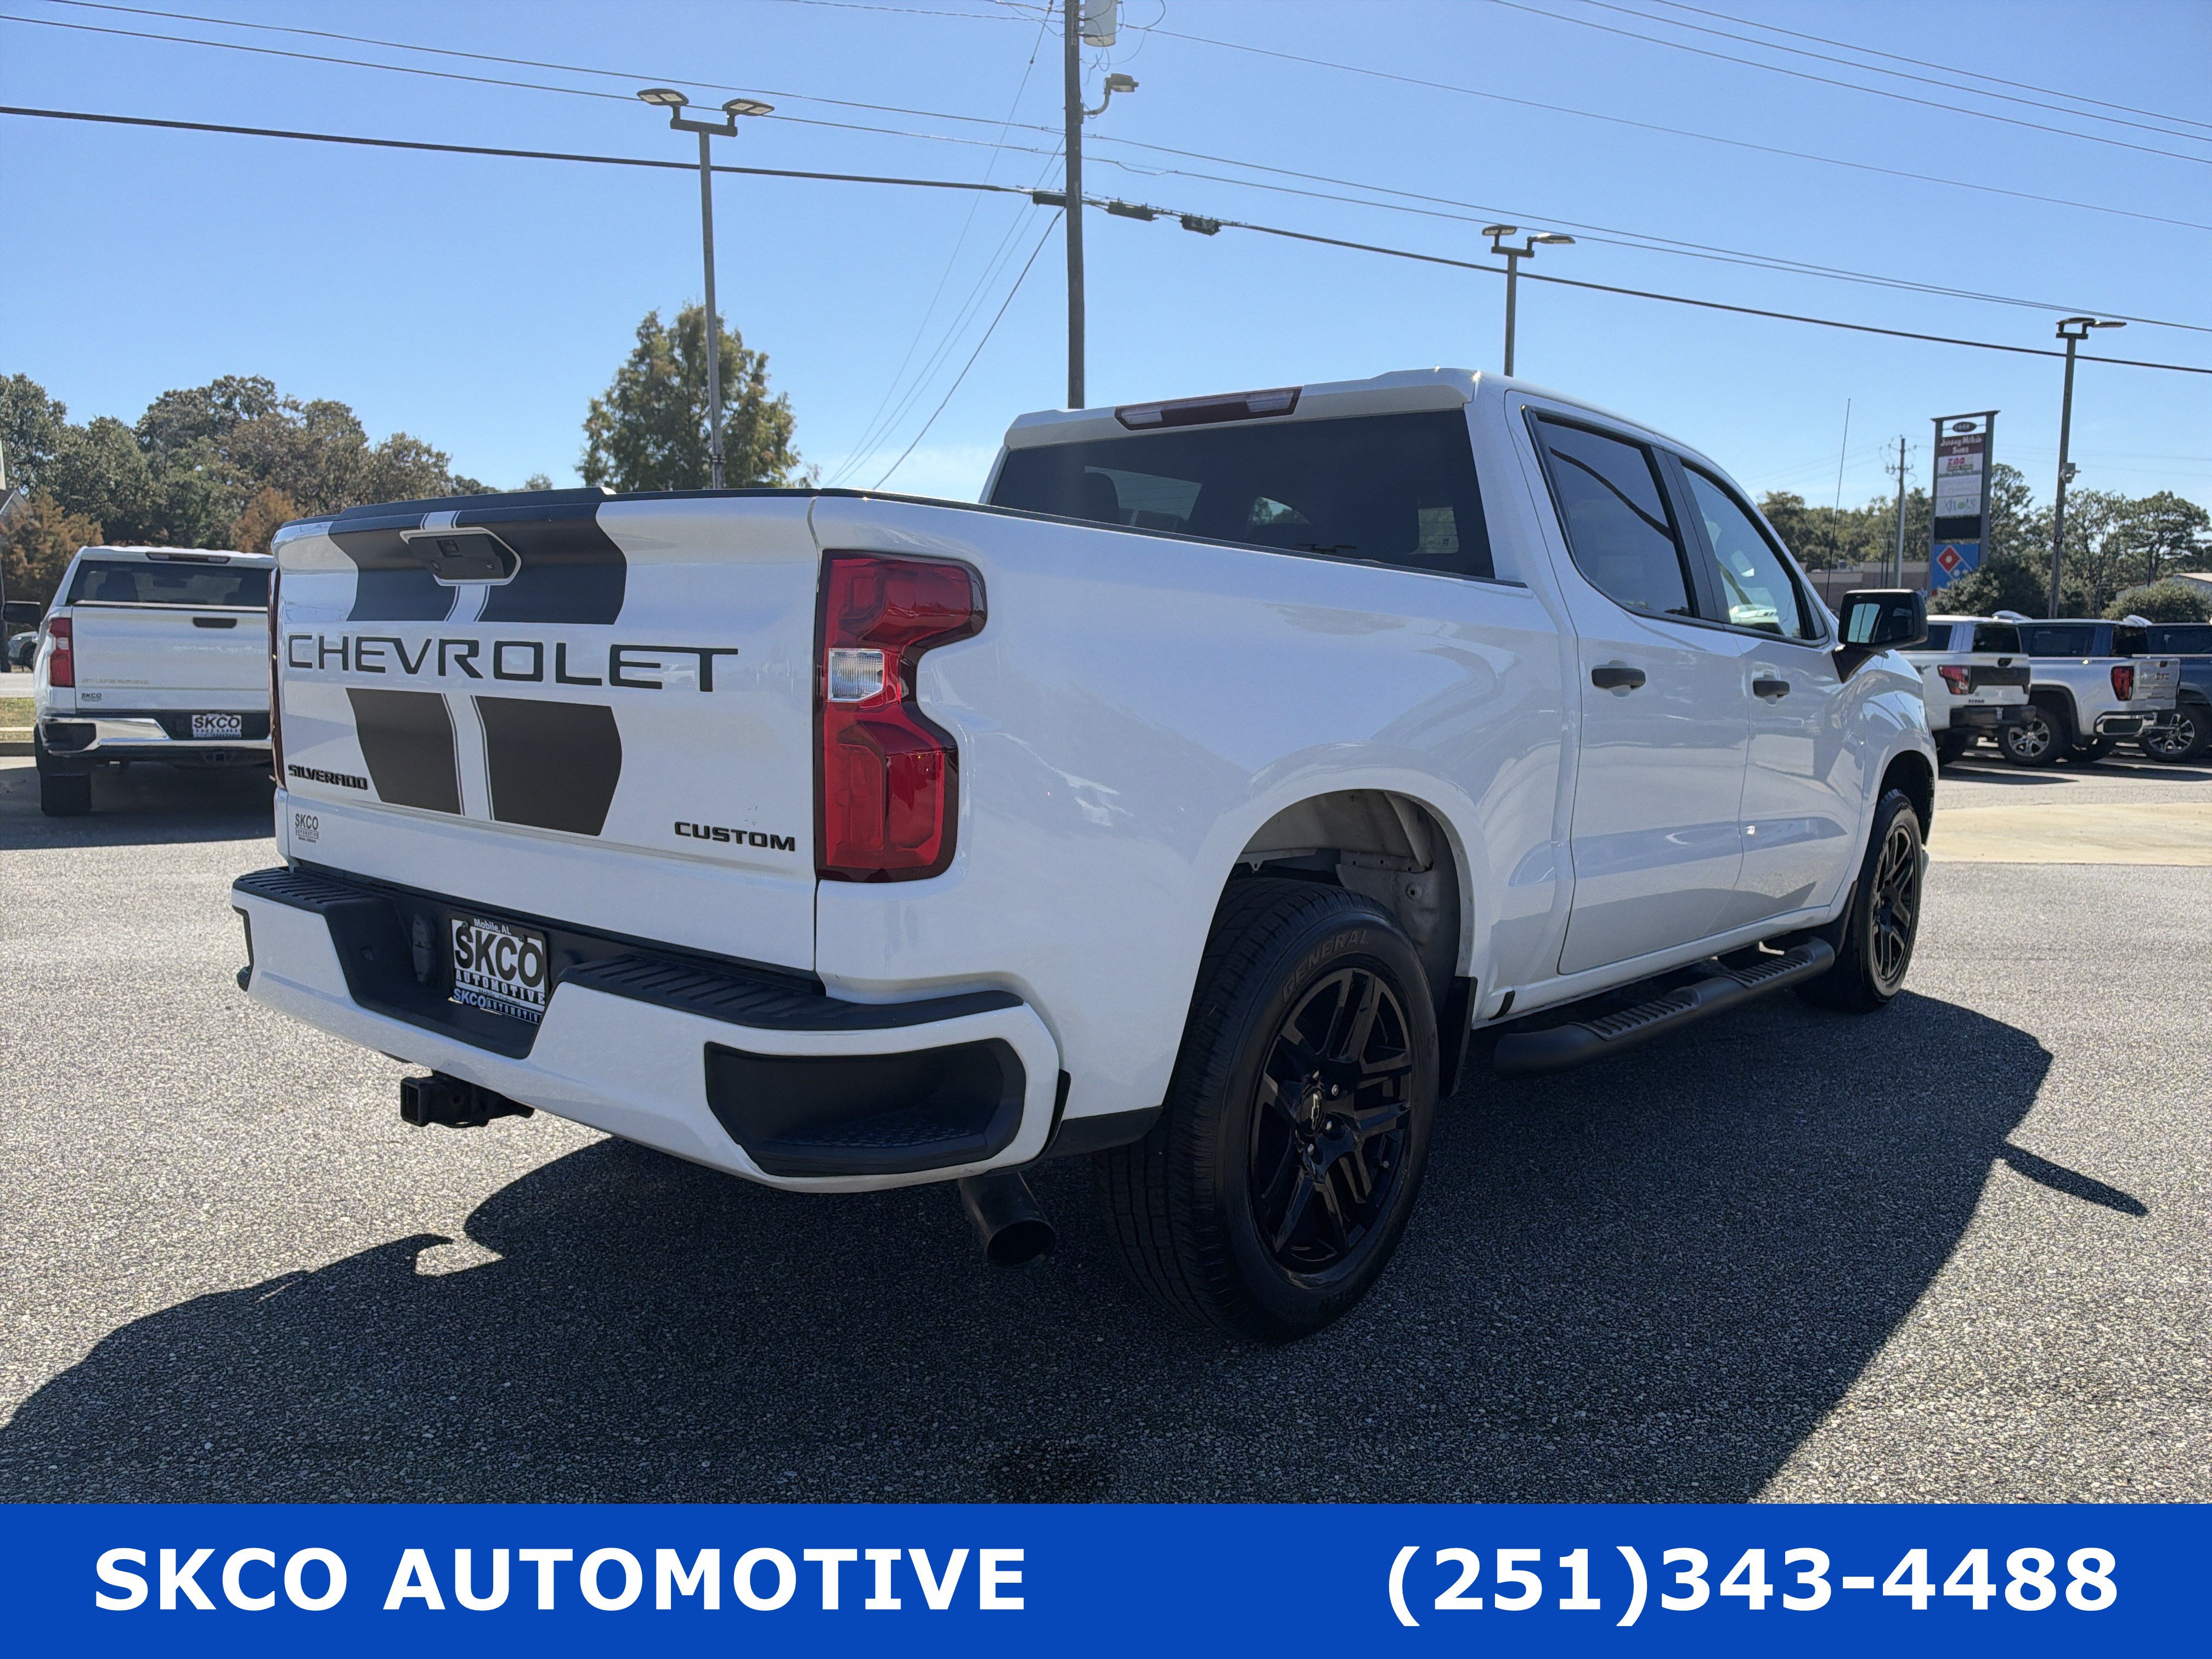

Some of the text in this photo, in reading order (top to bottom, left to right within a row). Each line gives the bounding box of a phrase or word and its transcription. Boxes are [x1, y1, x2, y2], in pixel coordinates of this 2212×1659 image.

[288, 635, 738, 692] CHEVROLET
[194, 716, 240, 729] SKCO
[288, 764, 368, 791] SILVERADO
[295, 813, 319, 831] SKCO
[674, 821, 795, 852] CUSTOM
[501, 924, 512, 935] AL
[455, 926, 544, 988] SKCO
[1282, 929, 1370, 1002] GENERAL
[453, 988, 487, 1009] SKCO
[455, 969, 545, 1005] AUTOMOTIVE
[487, 1000, 540, 1023] AUTOMOTIV
